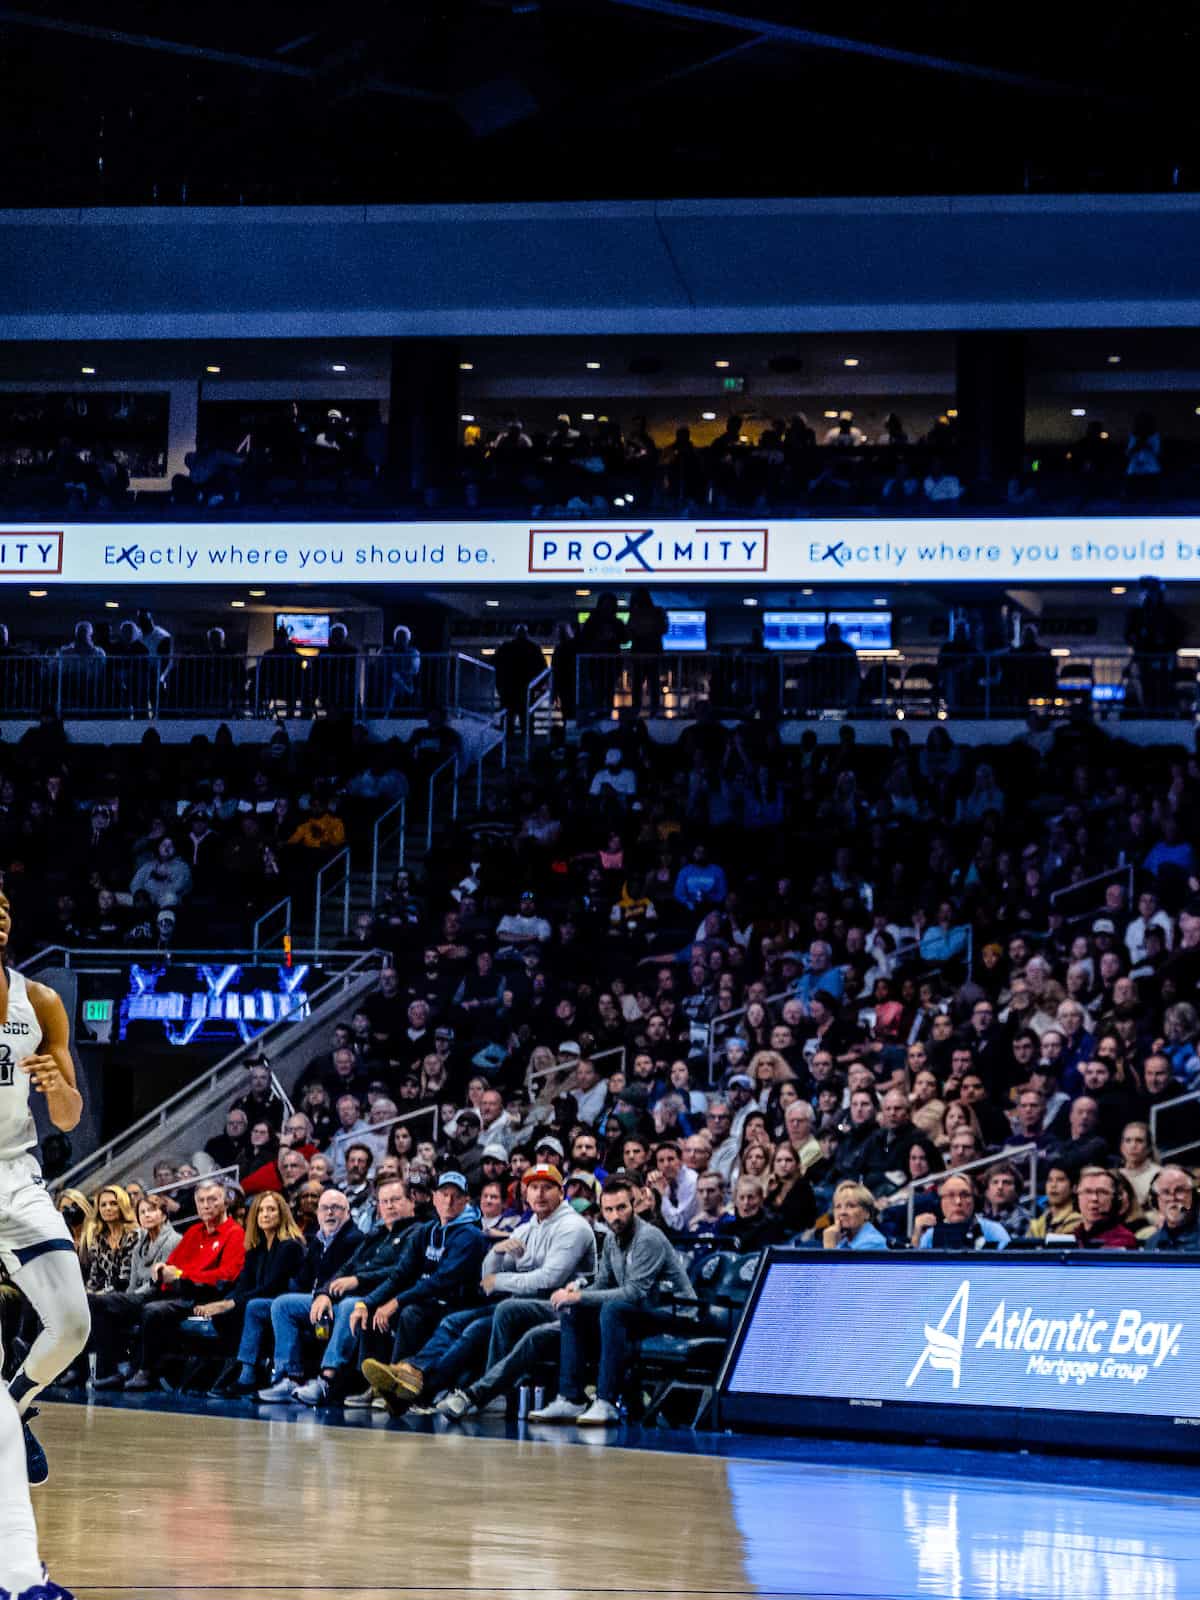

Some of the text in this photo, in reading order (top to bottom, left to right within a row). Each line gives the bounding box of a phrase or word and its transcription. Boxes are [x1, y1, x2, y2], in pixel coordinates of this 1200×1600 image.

[208, 544, 288, 564] where
[299, 549, 344, 568] you
[355, 544, 444, 564] should
[457, 544, 496, 564] be.
[543, 529, 757, 572] PROXIMITY
[918, 541, 1001, 562] where
[1011, 545, 1059, 566] you
[1071, 540, 1164, 561] should
[975, 1299, 1108, 1353] Atlantic
[1025, 1355, 1148, 1385] Mortgage Group
